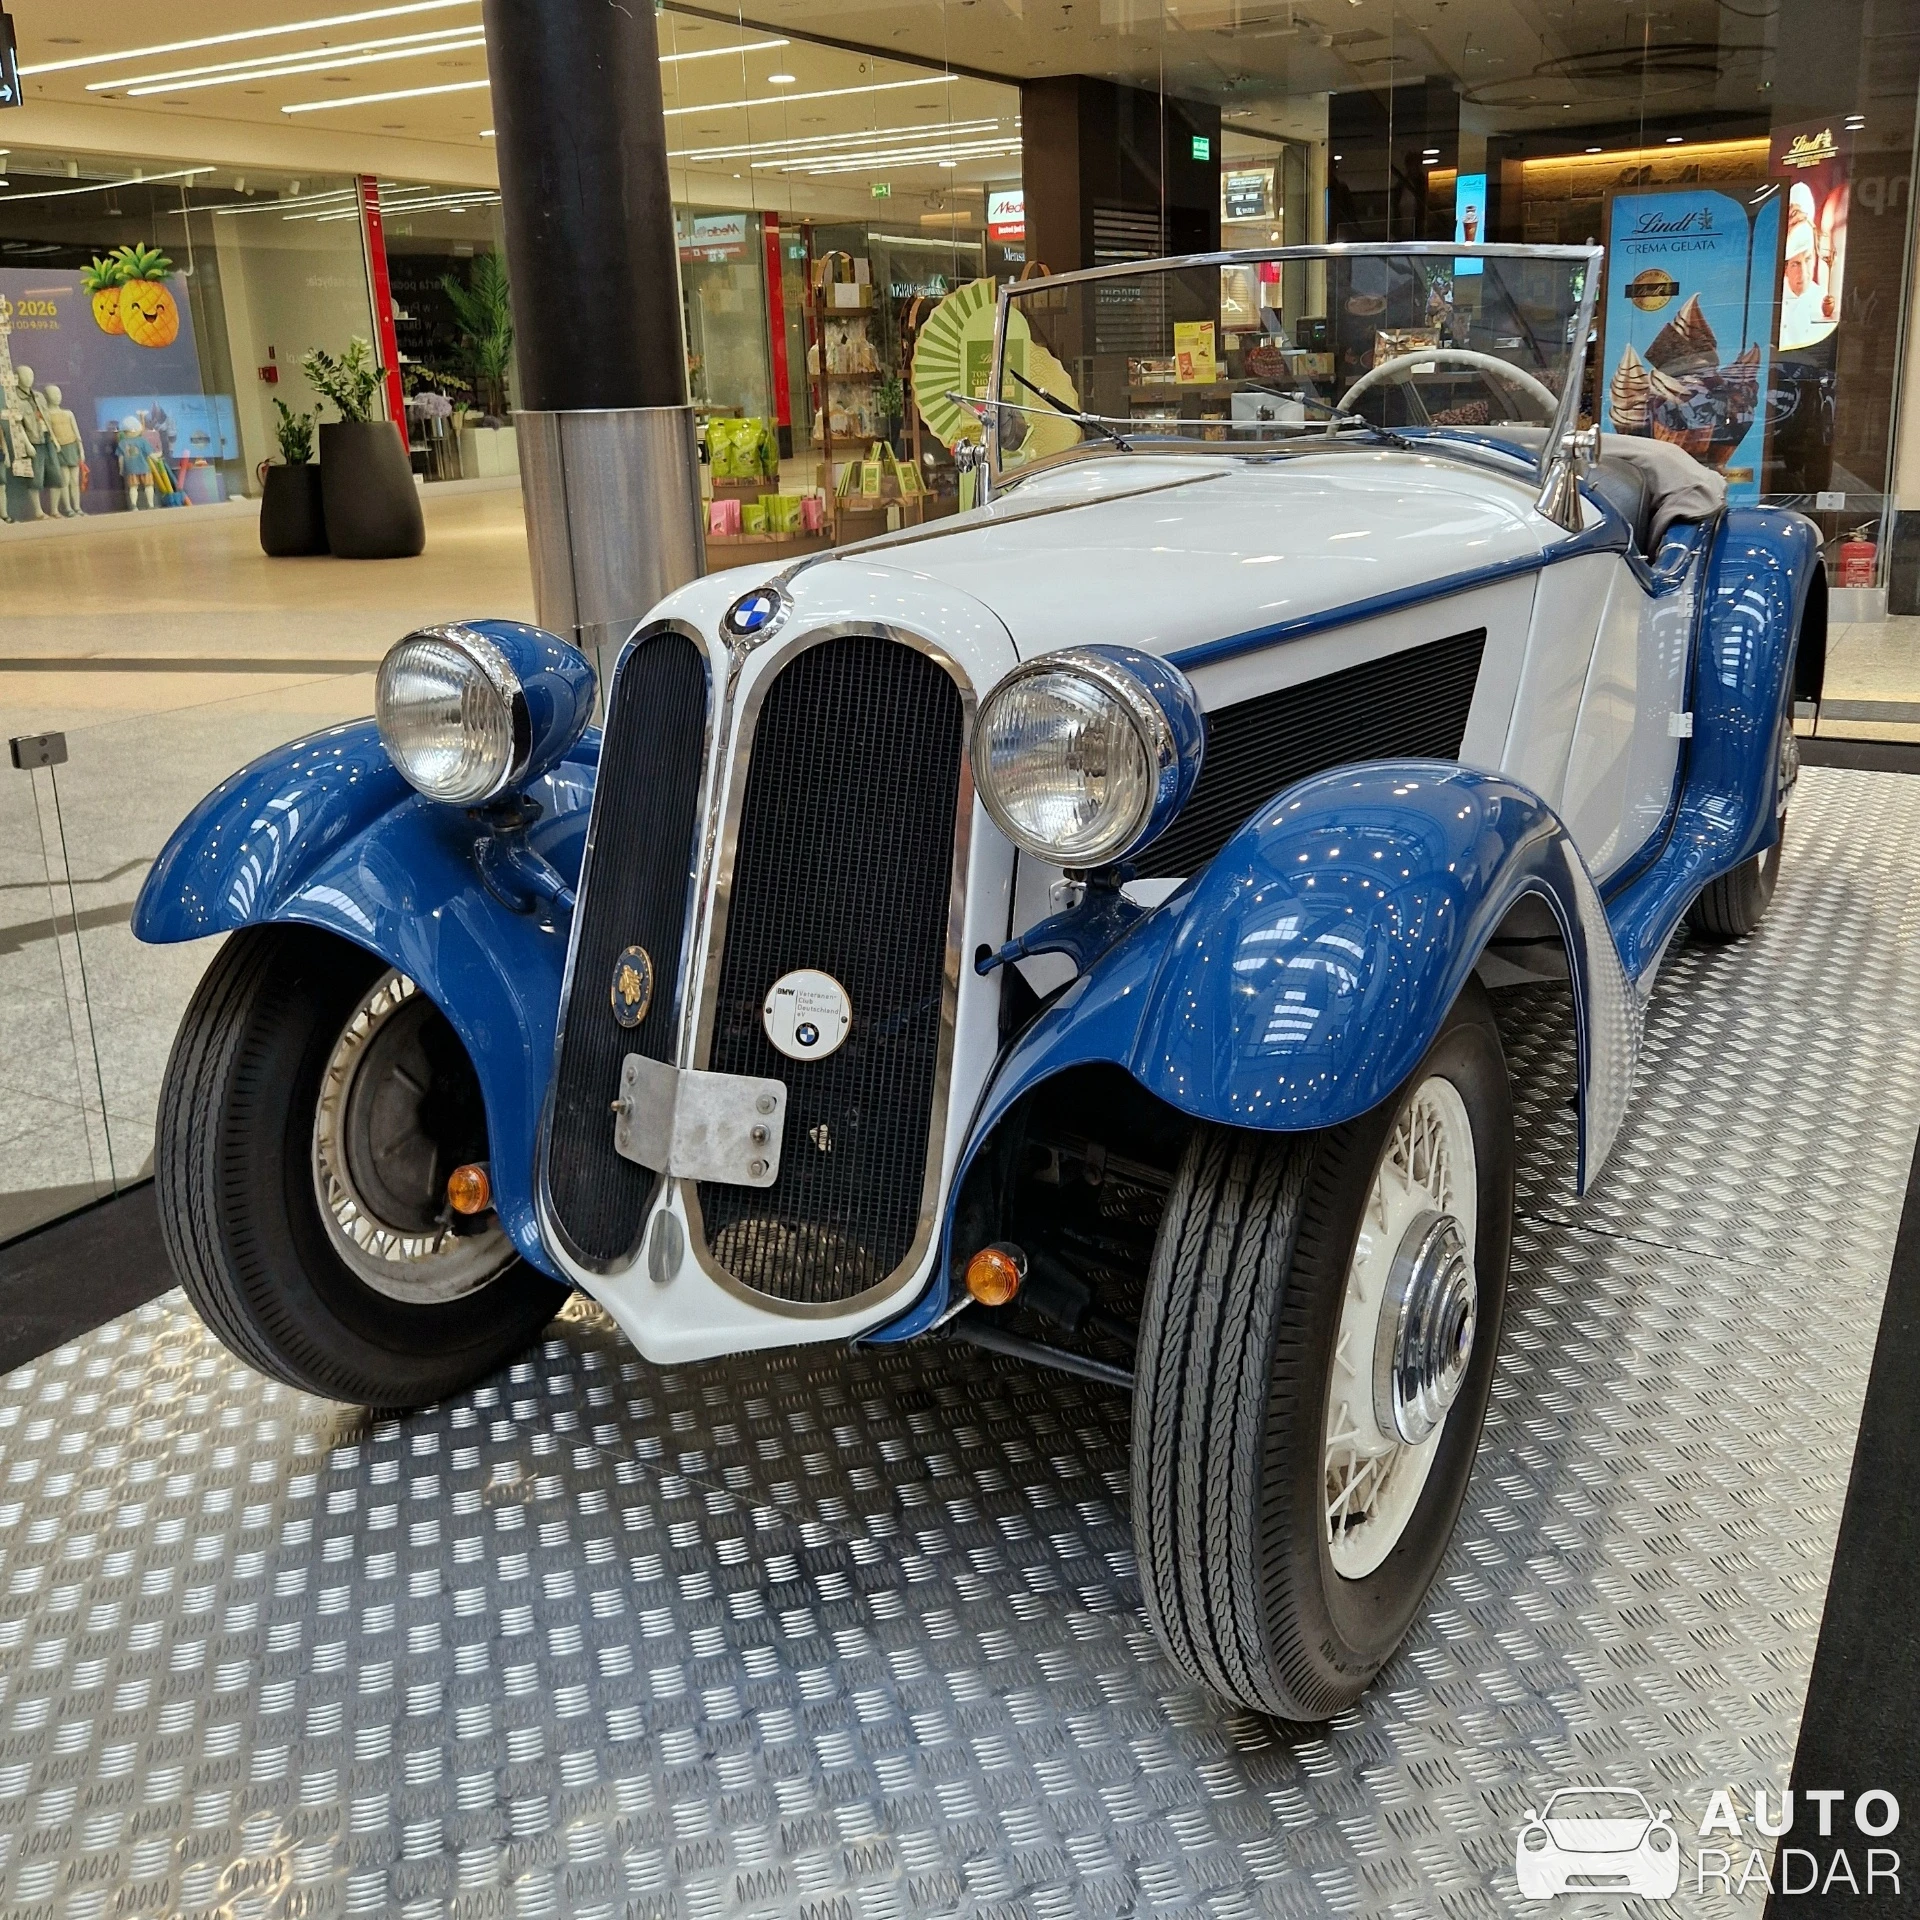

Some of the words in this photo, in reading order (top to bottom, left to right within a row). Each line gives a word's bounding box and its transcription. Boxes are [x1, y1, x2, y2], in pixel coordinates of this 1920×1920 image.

[1632, 211, 1698, 234] Lindt
[1626, 243, 1668, 255] CREMA
[1671, 240, 1715, 252] GELATA
[17, 301, 58, 316] 2026
[777, 988, 795, 996] BMW
[797, 1004, 839, 1014] Deutschland
